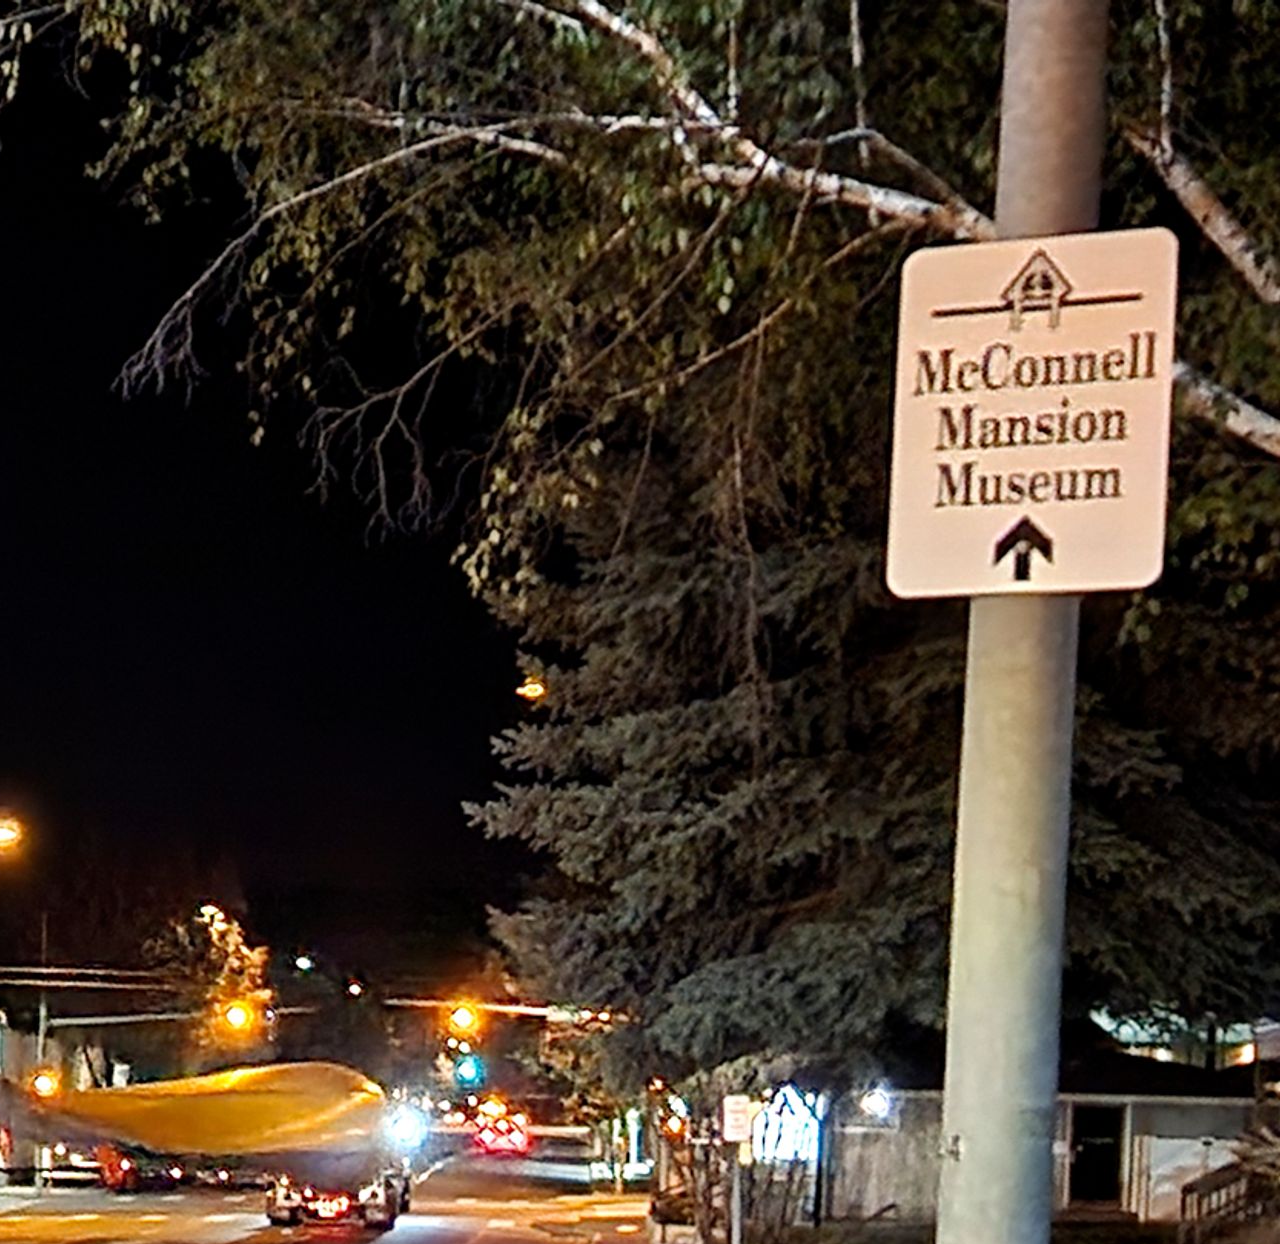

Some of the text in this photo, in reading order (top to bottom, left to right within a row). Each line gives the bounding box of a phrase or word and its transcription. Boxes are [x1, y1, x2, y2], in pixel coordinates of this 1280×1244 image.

[913, 331, 1156, 395] McConnell
[935, 397, 1128, 450] Mansion
[935, 462, 1122, 507] Museum
